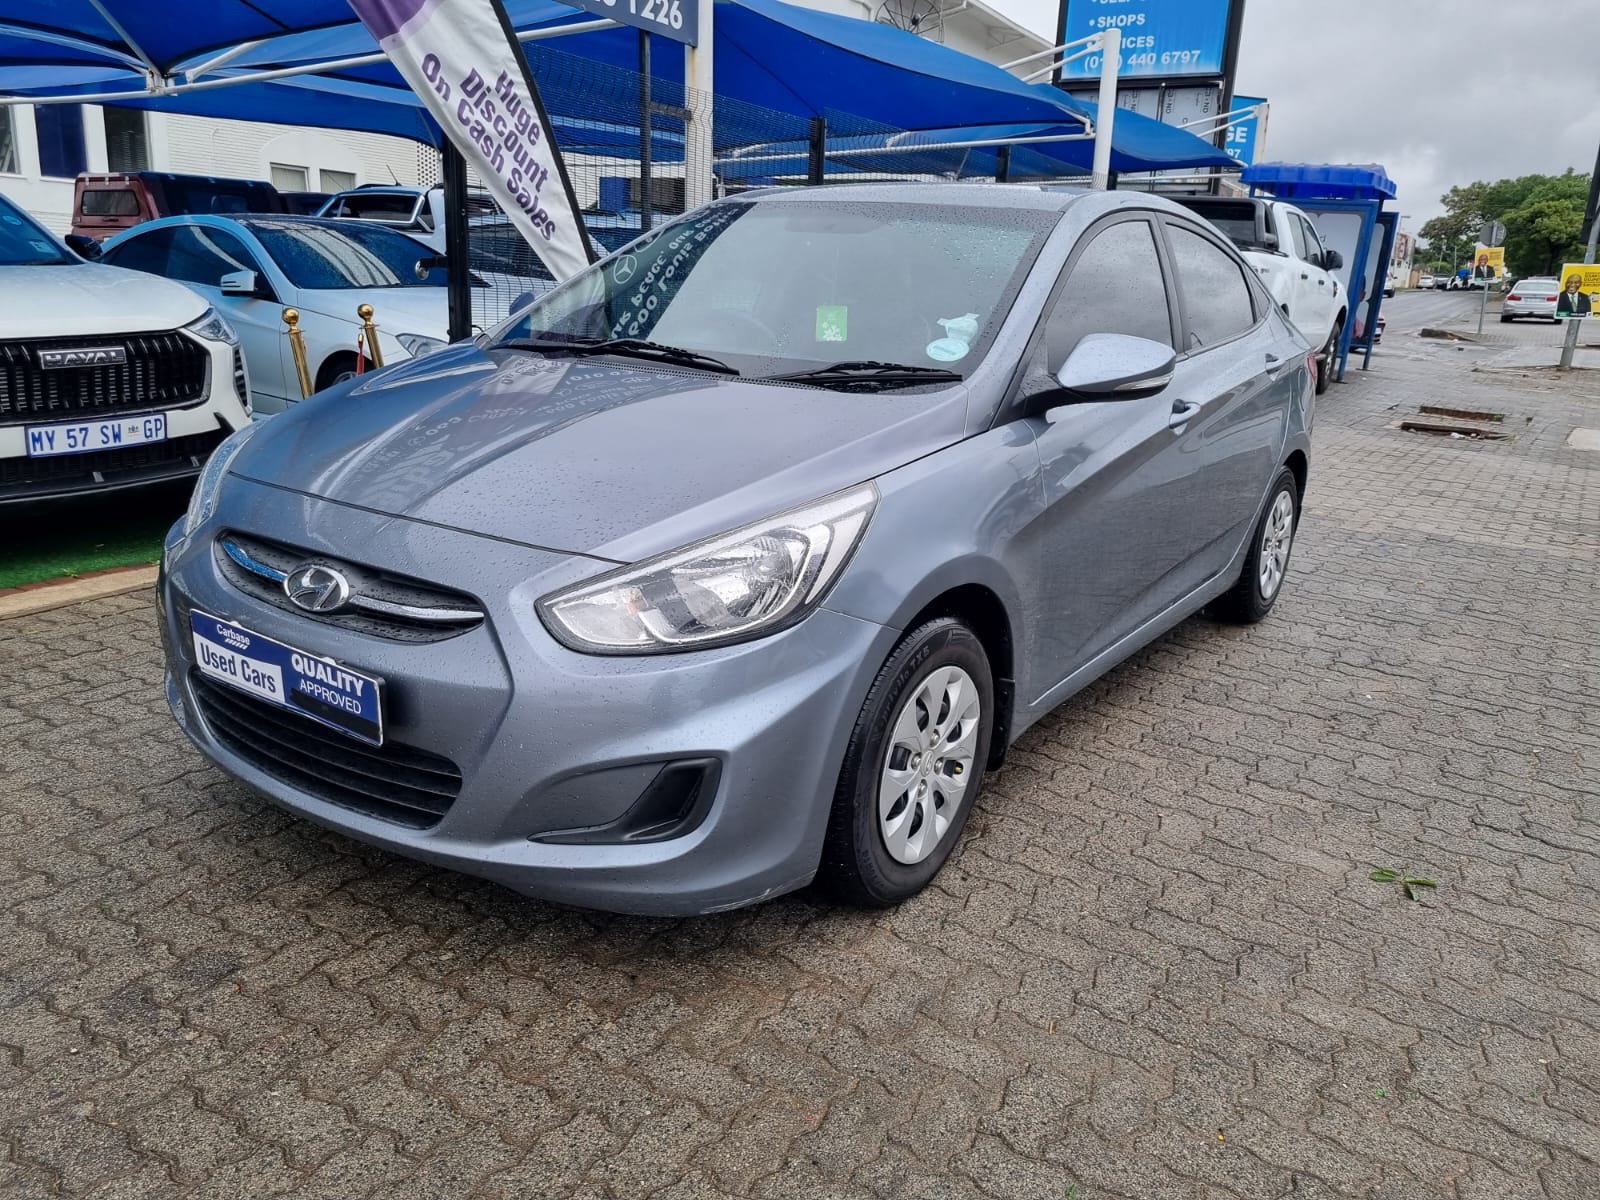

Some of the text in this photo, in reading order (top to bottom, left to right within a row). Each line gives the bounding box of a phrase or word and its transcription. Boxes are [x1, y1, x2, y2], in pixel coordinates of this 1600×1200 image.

[1096, 13, 1146, 28] SHOPS
[1121, 35, 1155, 48] ICES
[1127, 52, 1157, 66] 440
[1160, 49, 1201, 65] 6797
[495, 70, 540, 146] Huge
[422, 53, 556, 241] On Cash Sales
[460, 68, 548, 192] Discount
[45, 351, 124, 365] HAVAL
[31, 418, 163, 452] MY 57 SW GP
[216, 624, 250, 646] Carbase
[200, 643, 276, 694] Used Cars
[291, 653, 364, 697] QUALITY
[300, 679, 362, 714] APPROVED
